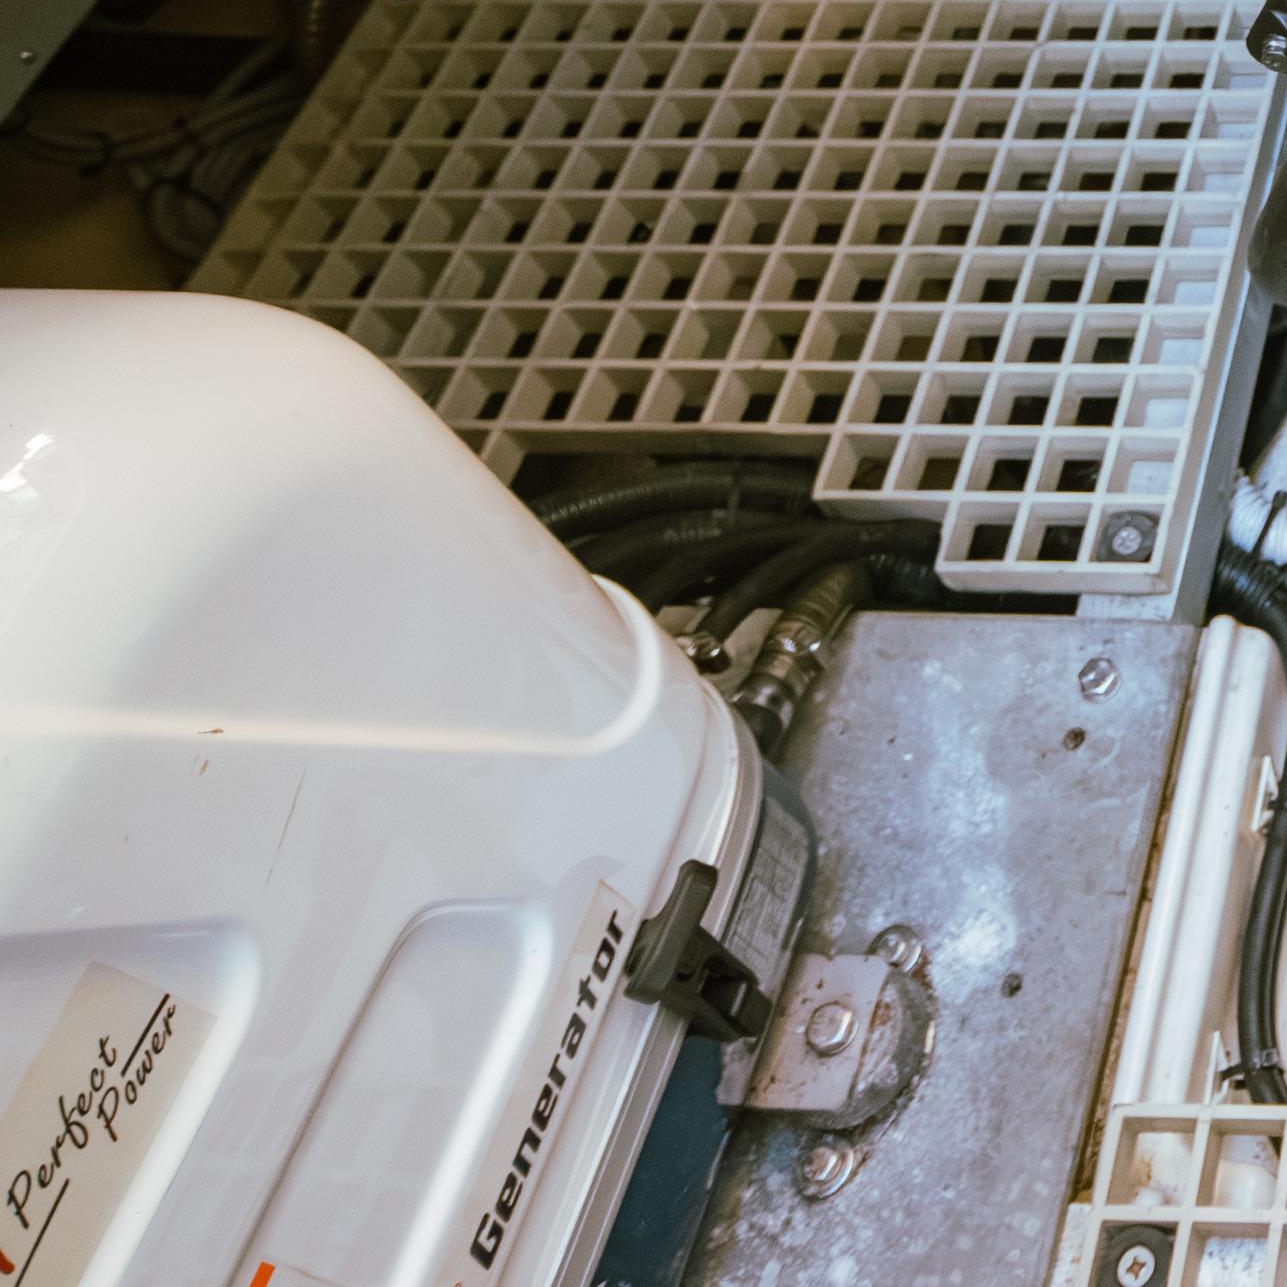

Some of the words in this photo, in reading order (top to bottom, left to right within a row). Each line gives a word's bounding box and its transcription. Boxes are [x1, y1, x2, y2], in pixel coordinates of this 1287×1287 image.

[7, 1034, 117, 1230] Perfect
[97, 1003, 177, 1143] Power
[469, 909, 624, 1271] Generator
